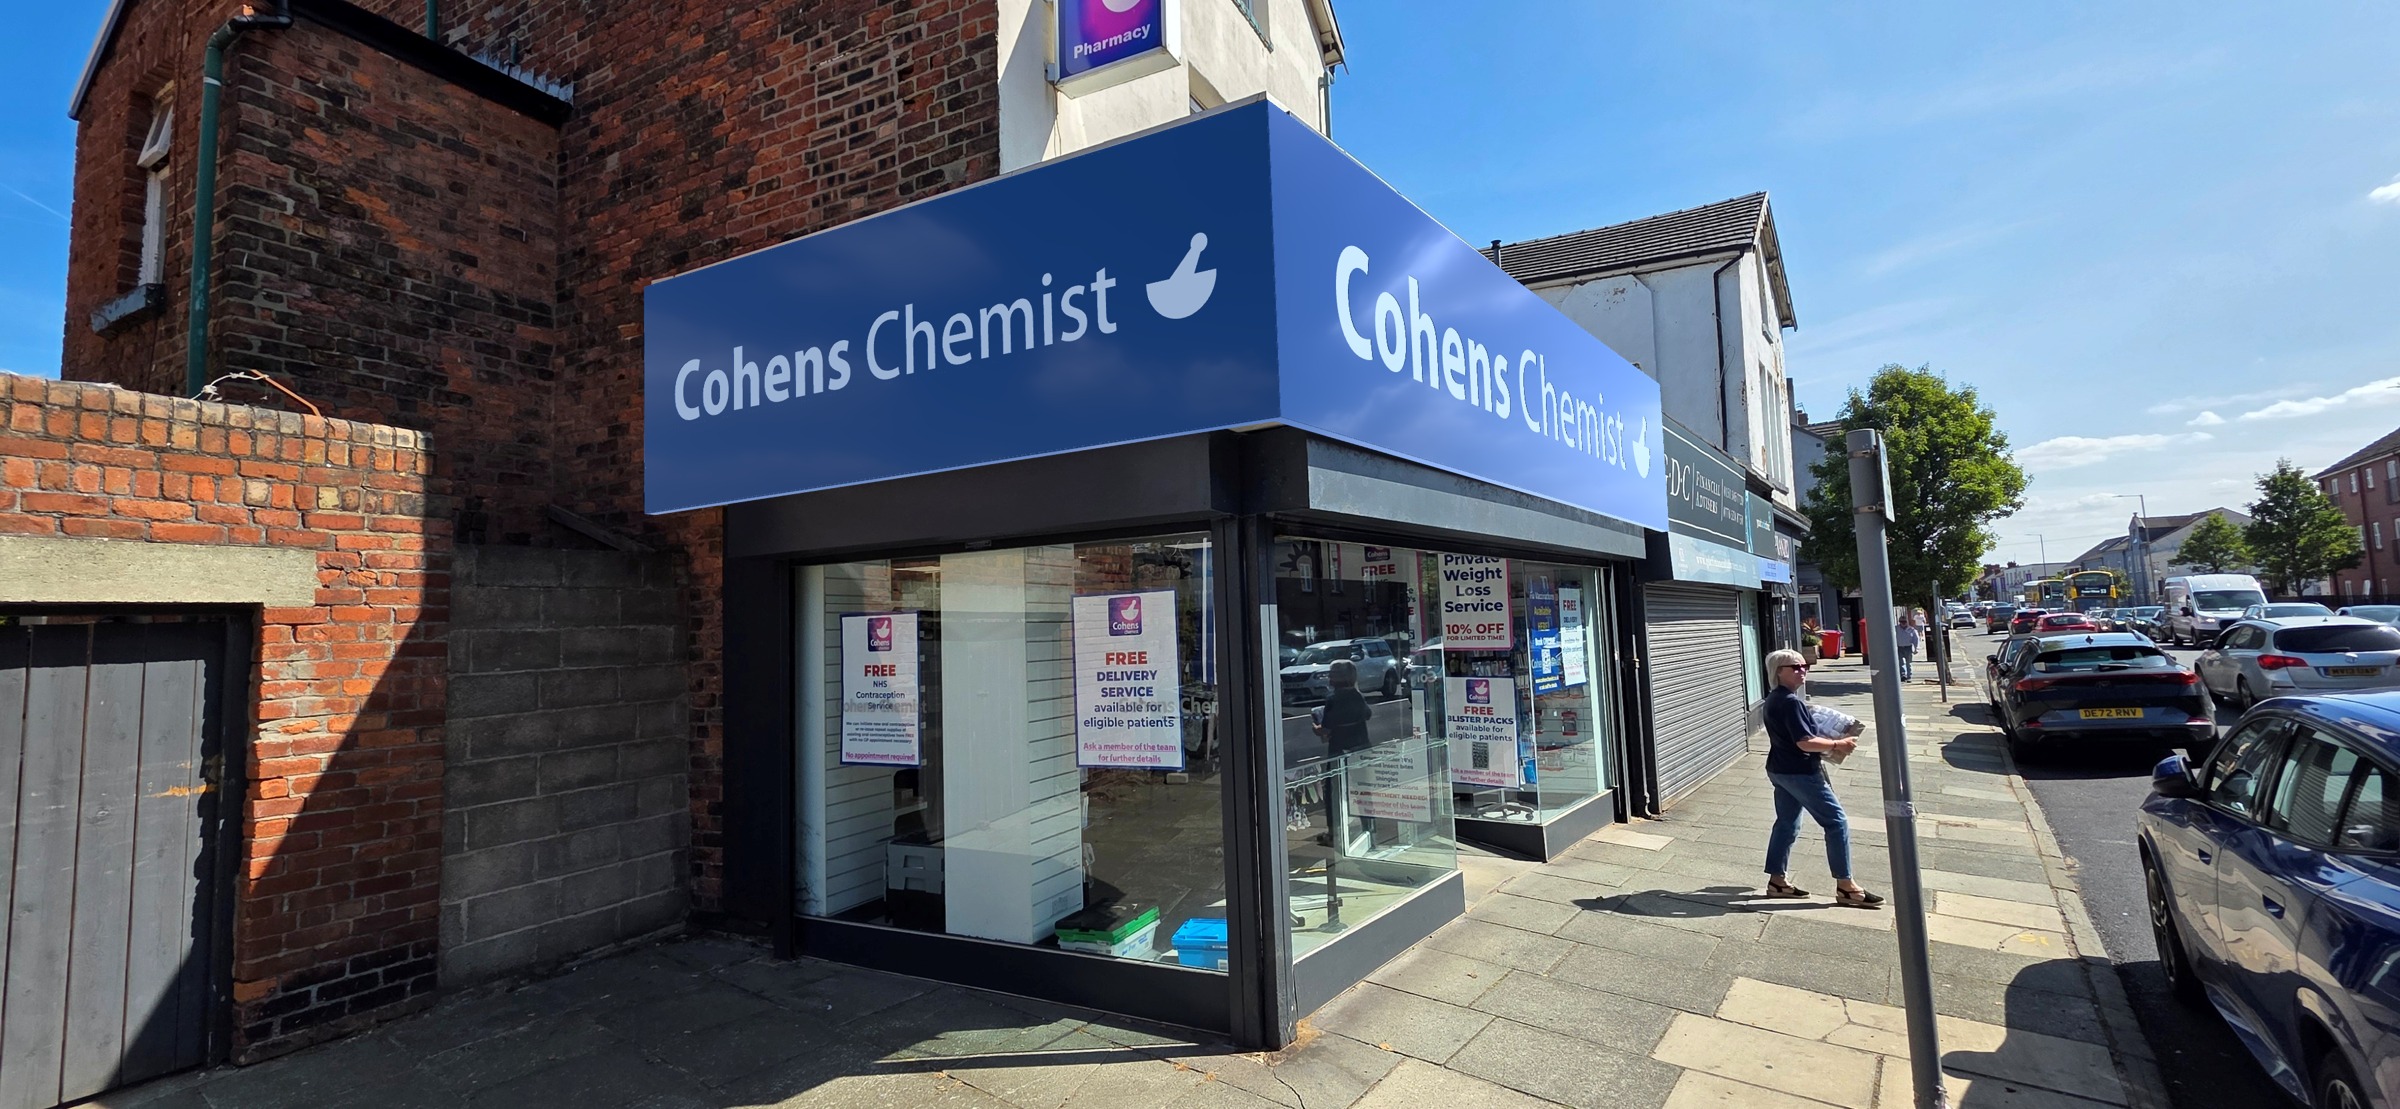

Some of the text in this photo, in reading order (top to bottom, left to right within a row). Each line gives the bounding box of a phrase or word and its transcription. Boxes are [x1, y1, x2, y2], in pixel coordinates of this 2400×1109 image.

[1073, 24, 1151, 59] Pharmacy
[674, 267, 1117, 421] Cohens Chemist
[1335, 245, 1627, 471] Cohens Chemist
[1361, 564, 1396, 577] FREE
[1443, 567, 1502, 583] Weight
[1456, 585, 1491, 596] Loss
[1444, 599, 1504, 613] Service
[1563, 600, 1577, 611] FREE
[1112, 621, 1139, 630] Cohens
[1446, 623, 1504, 635] 10% OFF
[870, 639, 890, 647] Cohens
[1105, 651, 1148, 665] FREE
[864, 665, 896, 677] FREE
[1097, 670, 1158, 682] DELIVERY
[856, 690, 905, 700] Contraception
[1101, 687, 1154, 697] SERVICE
[868, 701, 893, 710] Service
[1094, 702, 1162, 712] available for
[1464, 706, 1494, 715] FREE
[2083, 708, 2137, 717] DE72 RNV
[1083, 717, 1175, 729] eligible patients
[1447, 715, 1514, 725] BLISTER PACKS
[1455, 724, 1490, 732] available
[1449, 732, 1512, 741] eligible patients
[854, 752, 890, 760] appointment
[891, 753, 915, 761] required!
[1110, 754, 1135, 762] further
[1137, 754, 1161, 762] details
